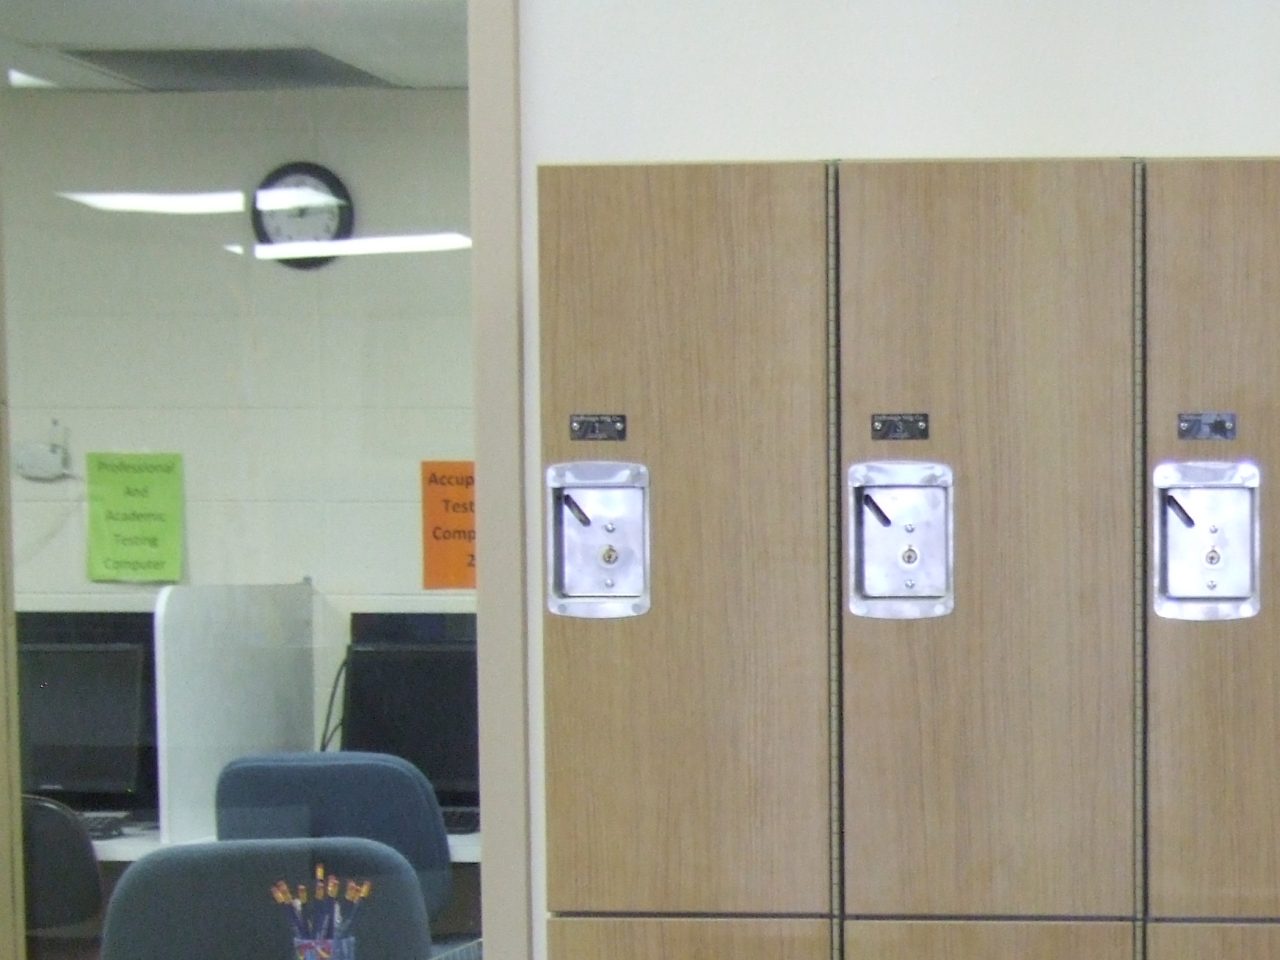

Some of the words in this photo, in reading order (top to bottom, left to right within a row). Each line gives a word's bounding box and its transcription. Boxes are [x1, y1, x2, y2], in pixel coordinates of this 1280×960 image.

[97, 461, 175, 474] Professional
[105, 510, 166, 522] Academic
[113, 533, 159, 549] Testing
[103, 558, 166, 571] Computer
